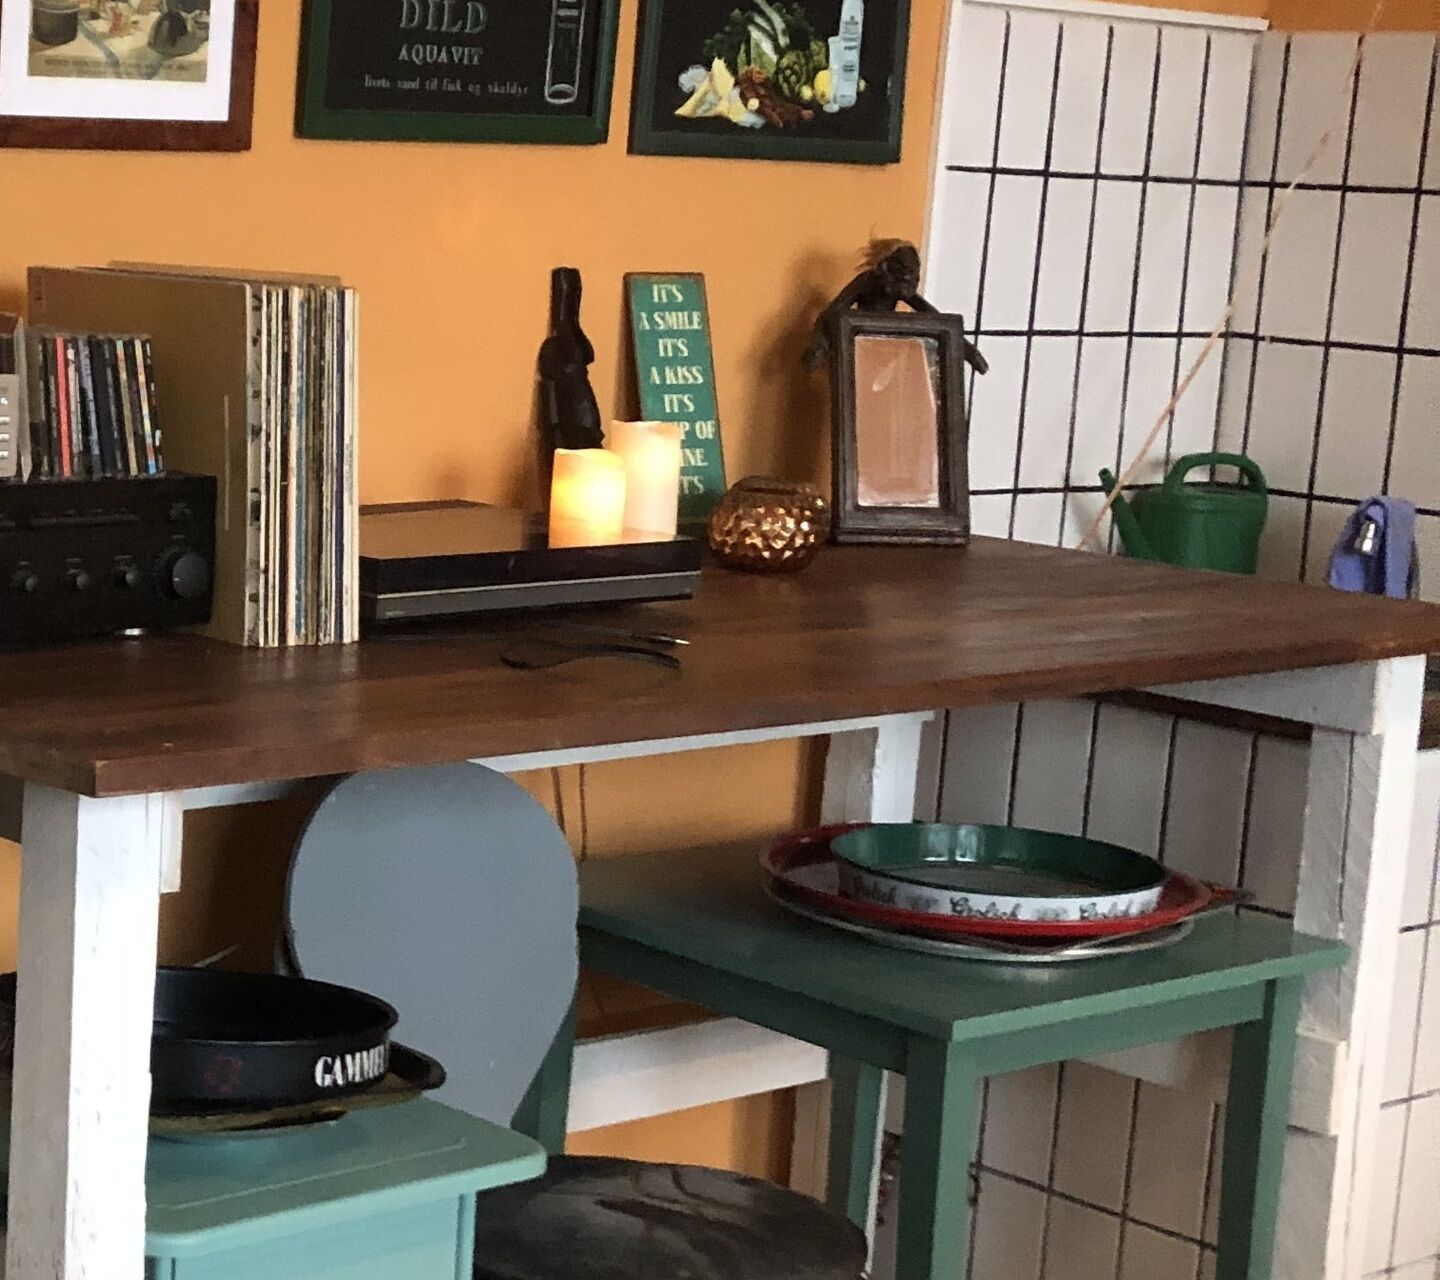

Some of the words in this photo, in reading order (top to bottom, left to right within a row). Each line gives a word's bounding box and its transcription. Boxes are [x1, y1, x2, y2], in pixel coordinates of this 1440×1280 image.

[398, 43, 484, 66] AQUAVIT
[652, 284, 684, 303] IT'S
[639, 312, 650, 330] A
[654, 311, 703, 330] SMILE
[658, 338, 689, 357] IT'S
[650, 366, 660, 385] A
[665, 366, 704, 385] KISS
[663, 394, 695, 413] IT'S
[695, 420, 716, 440] OF
[680, 448, 708, 467] INE
[679, 475, 705, 495] T'S
